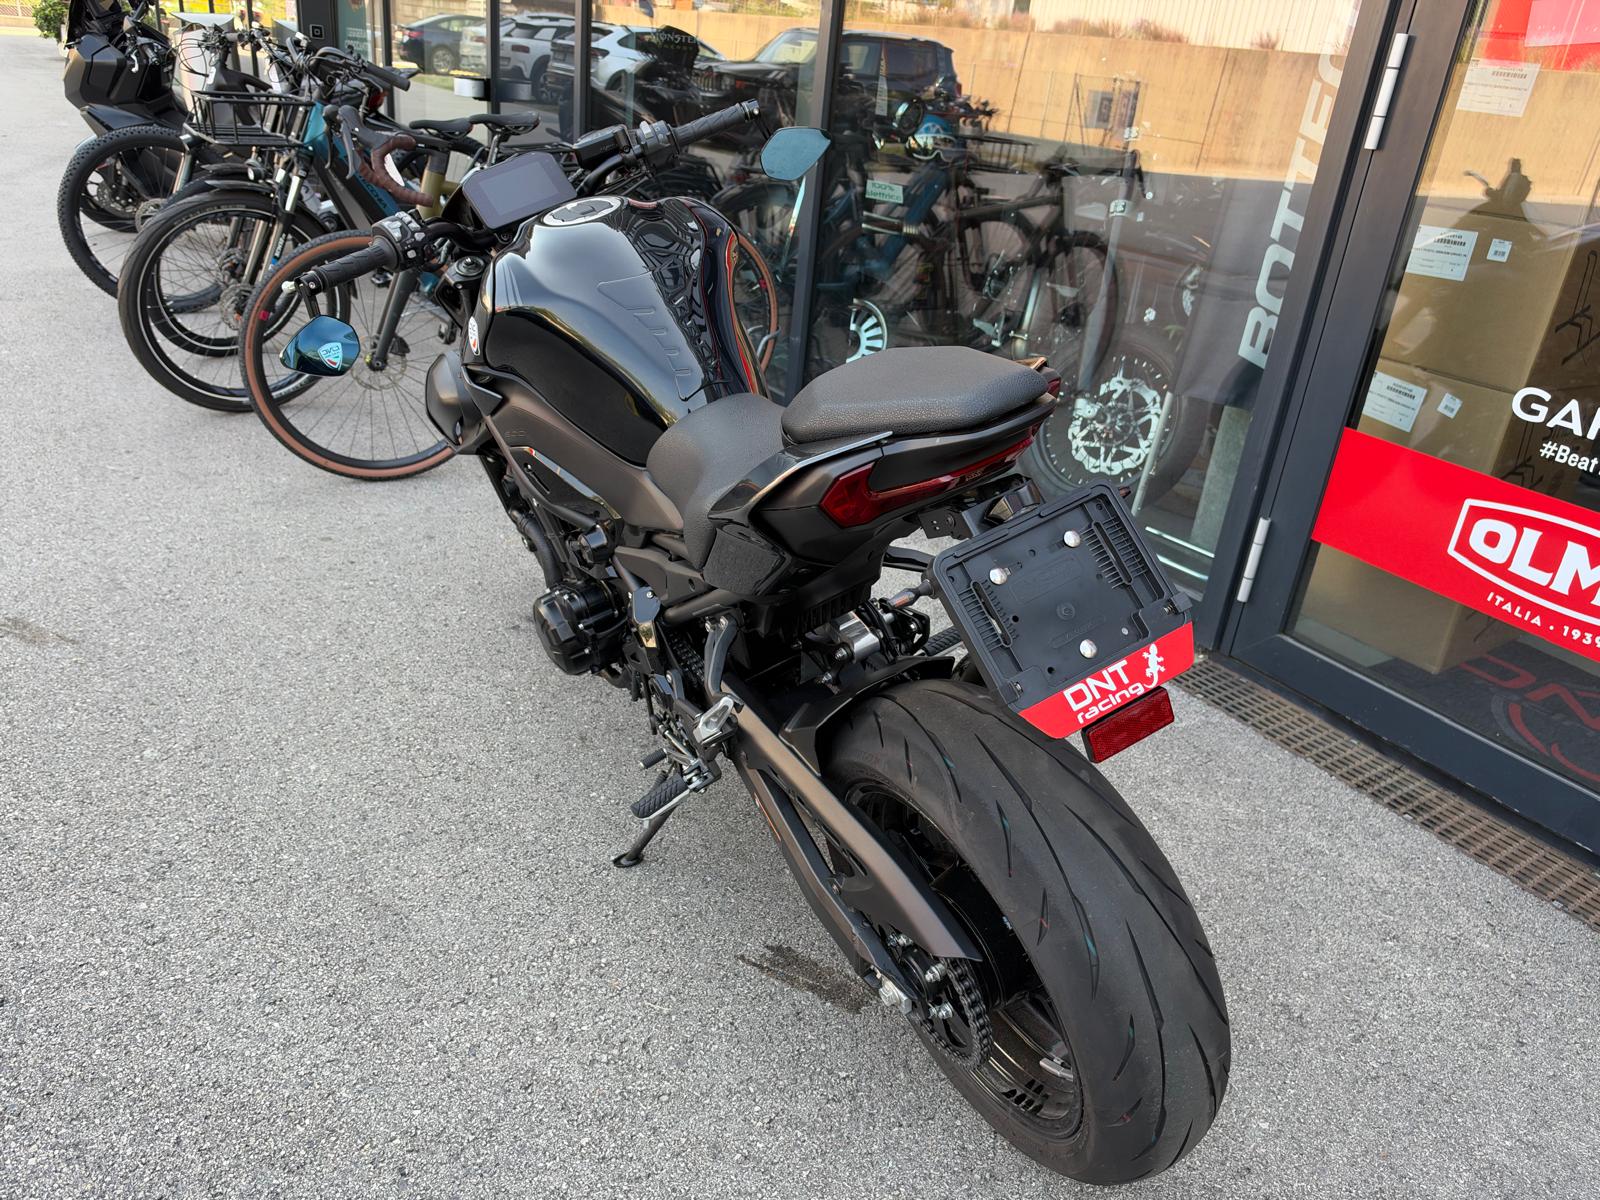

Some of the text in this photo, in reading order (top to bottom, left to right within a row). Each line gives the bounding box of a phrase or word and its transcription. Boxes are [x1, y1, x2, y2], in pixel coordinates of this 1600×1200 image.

[1487, 592, 1542, 627] ITALIA
[1063, 659, 1130, 712] DNT
[1077, 682, 1145, 724] racing
